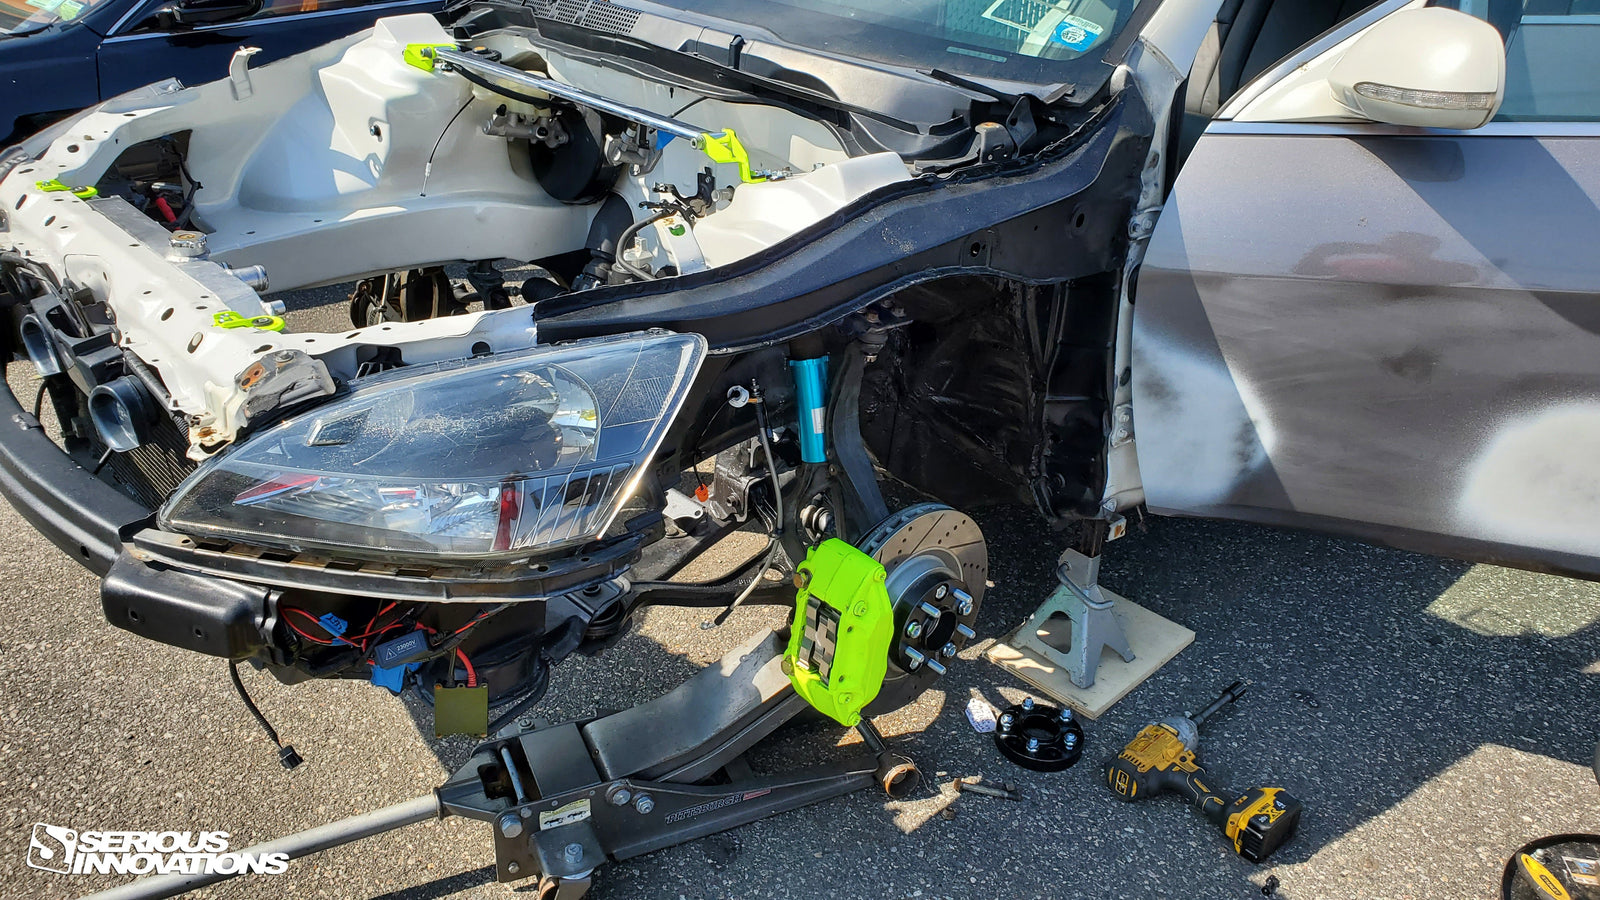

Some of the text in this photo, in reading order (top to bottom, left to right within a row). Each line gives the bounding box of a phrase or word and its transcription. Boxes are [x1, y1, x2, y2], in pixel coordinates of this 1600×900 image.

[327, 615, 343, 630] LEFT
[396, 639, 416, 651] 23000V
[664, 793, 744, 824] PITTSBURGH
